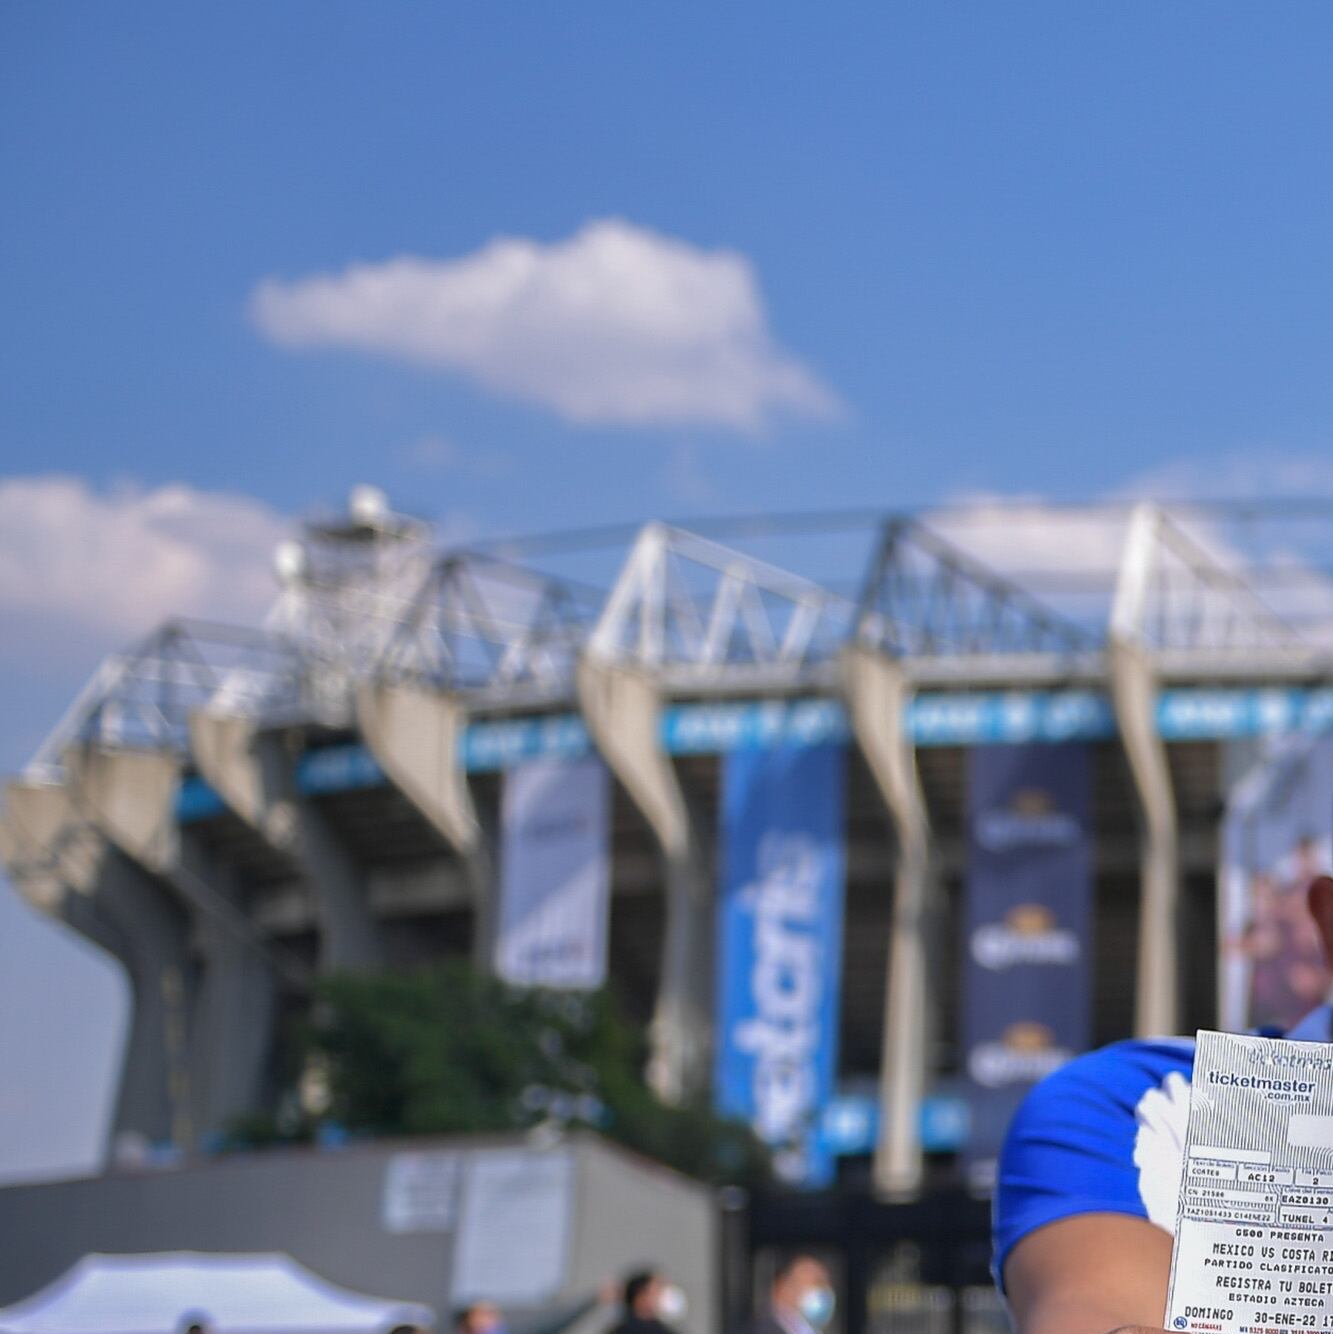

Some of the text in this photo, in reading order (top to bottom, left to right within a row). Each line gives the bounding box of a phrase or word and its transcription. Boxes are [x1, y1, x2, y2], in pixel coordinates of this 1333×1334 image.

[1208, 1071, 1316, 1094] ticketmaster
[1264, 1092, 1310, 1102] .com.mx
[1248, 1172, 1276, 1182] AC12
[1312, 1178, 1319, 1186] 2
[1281, 1196, 1329, 1205] EAZ0130
[1282, 1214, 1328, 1224] TUNEL 4
[1270, 1230, 1324, 1242] PRESENTA
[1212, 1243, 1254, 1257] MEXICO
[1261, 1247, 1276, 1258] VS
[1282, 1248, 1316, 1262] COSTA
[1204, 1258, 1254, 1270] PARTIDO
[1216, 1276, 1272, 1290] REGISTRA
[1279, 1280, 1292, 1292] TU
[1228, 1292, 1325, 1308] ESTADIO AZTECA
[1184, 1306, 1234, 1320] DOMINGO
[1254, 1312, 1316, 1327] 30-ENE-22
